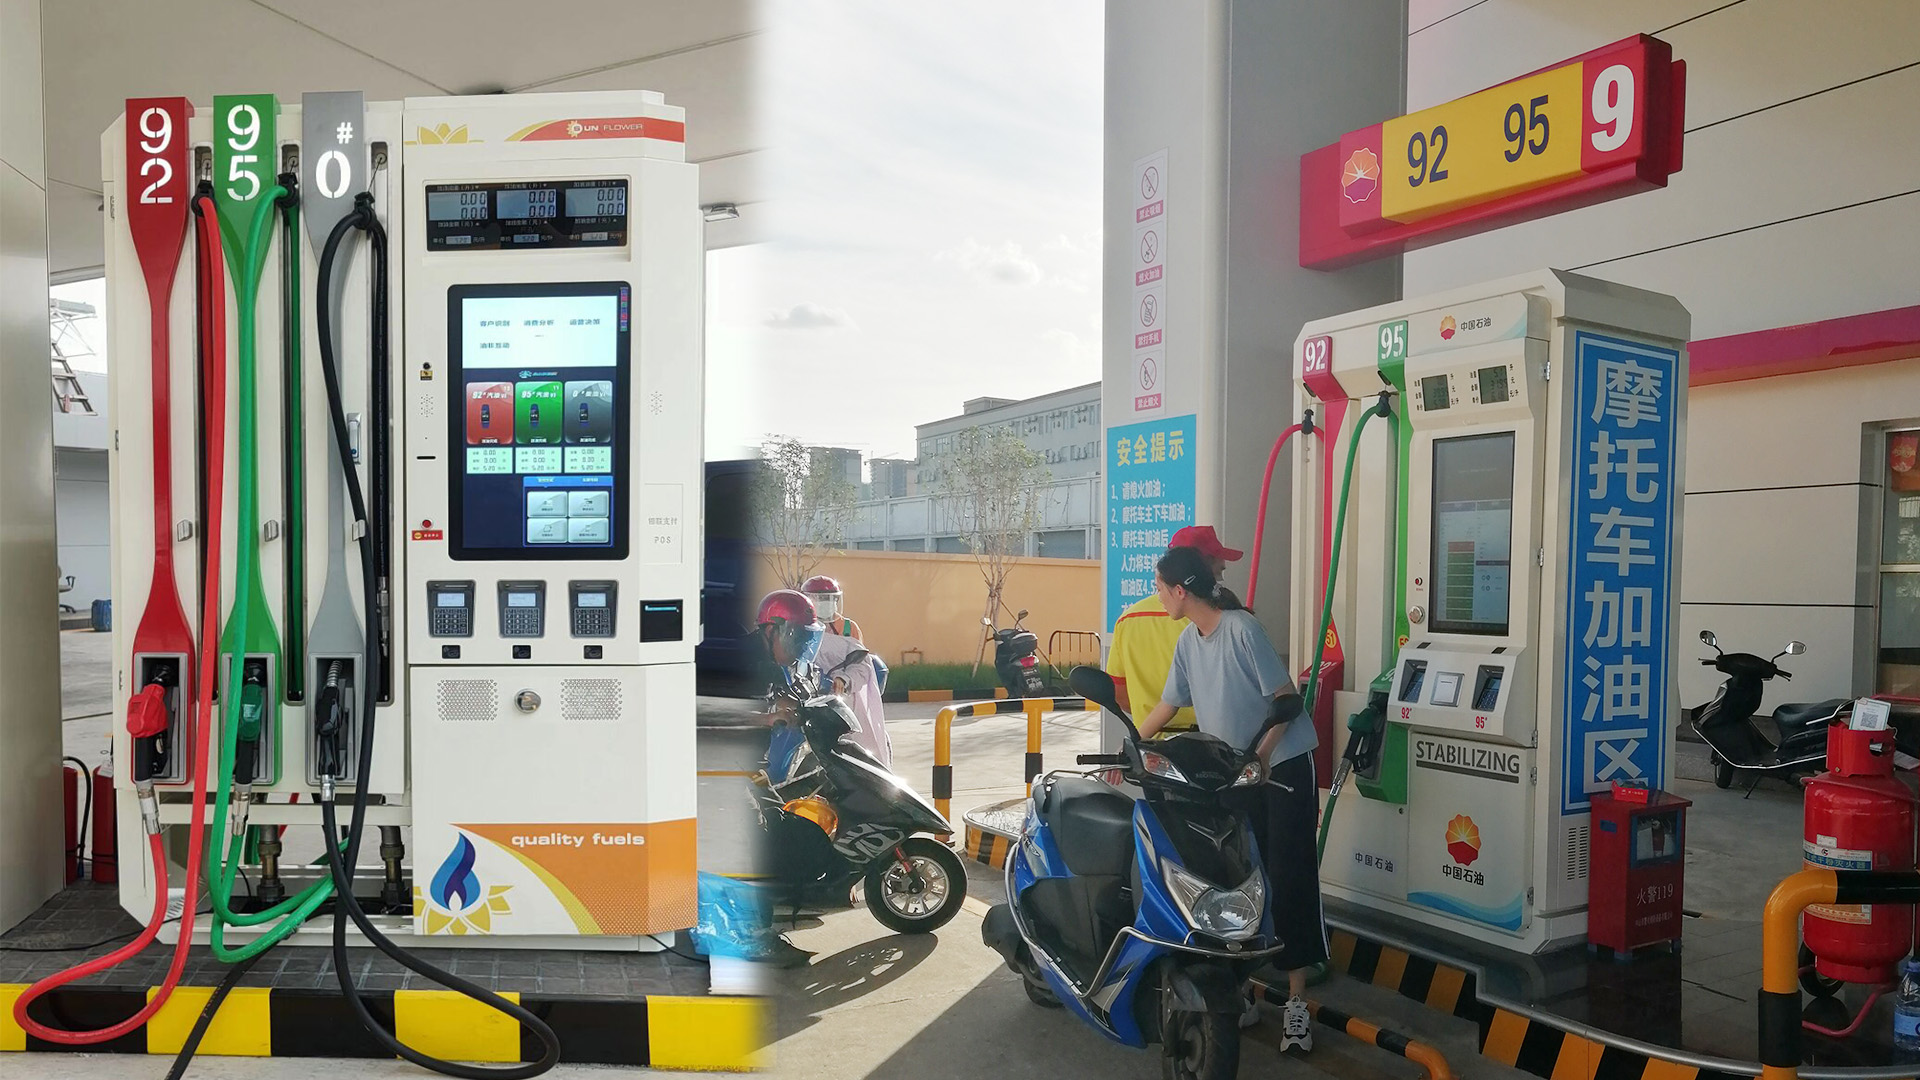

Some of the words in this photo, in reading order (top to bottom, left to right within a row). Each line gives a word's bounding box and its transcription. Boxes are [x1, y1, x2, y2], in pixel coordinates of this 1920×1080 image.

[1590, 64, 1635, 152] 9
[603, 124, 643, 132] FLOWER
[1503, 95, 1550, 163] 95
[139, 107, 173, 204] 92
[227, 104, 261, 201] 95
[1407, 125, 1449, 187] 92
[461, 193, 486, 205] 0.00
[529, 191, 555, 204] 0.00
[597, 189, 624, 202] 0.00
[461, 207, 487, 219] 0.00
[529, 205, 555, 218] 0.00
[597, 203, 624, 216] 0.00
[1460, 316, 1492, 331] 中国石油
[1381, 324, 1404, 360] 95
[1305, 339, 1326, 372] 92
[1117, 430, 1184, 467] 安全提示
[1121, 553, 1165, 573] 人力将车推
[1121, 578, 1160, 597] 加油区4.5
[1582, 359, 1663, 795] 摩托车加油区
[1416, 740, 1520, 774] STABILIZING
[511, 833, 584, 847] quality
[592, 833, 645, 846] fuels
[1355, 852, 1394, 873] 中国石油
[1442, 864, 1484, 886] 中国石油
